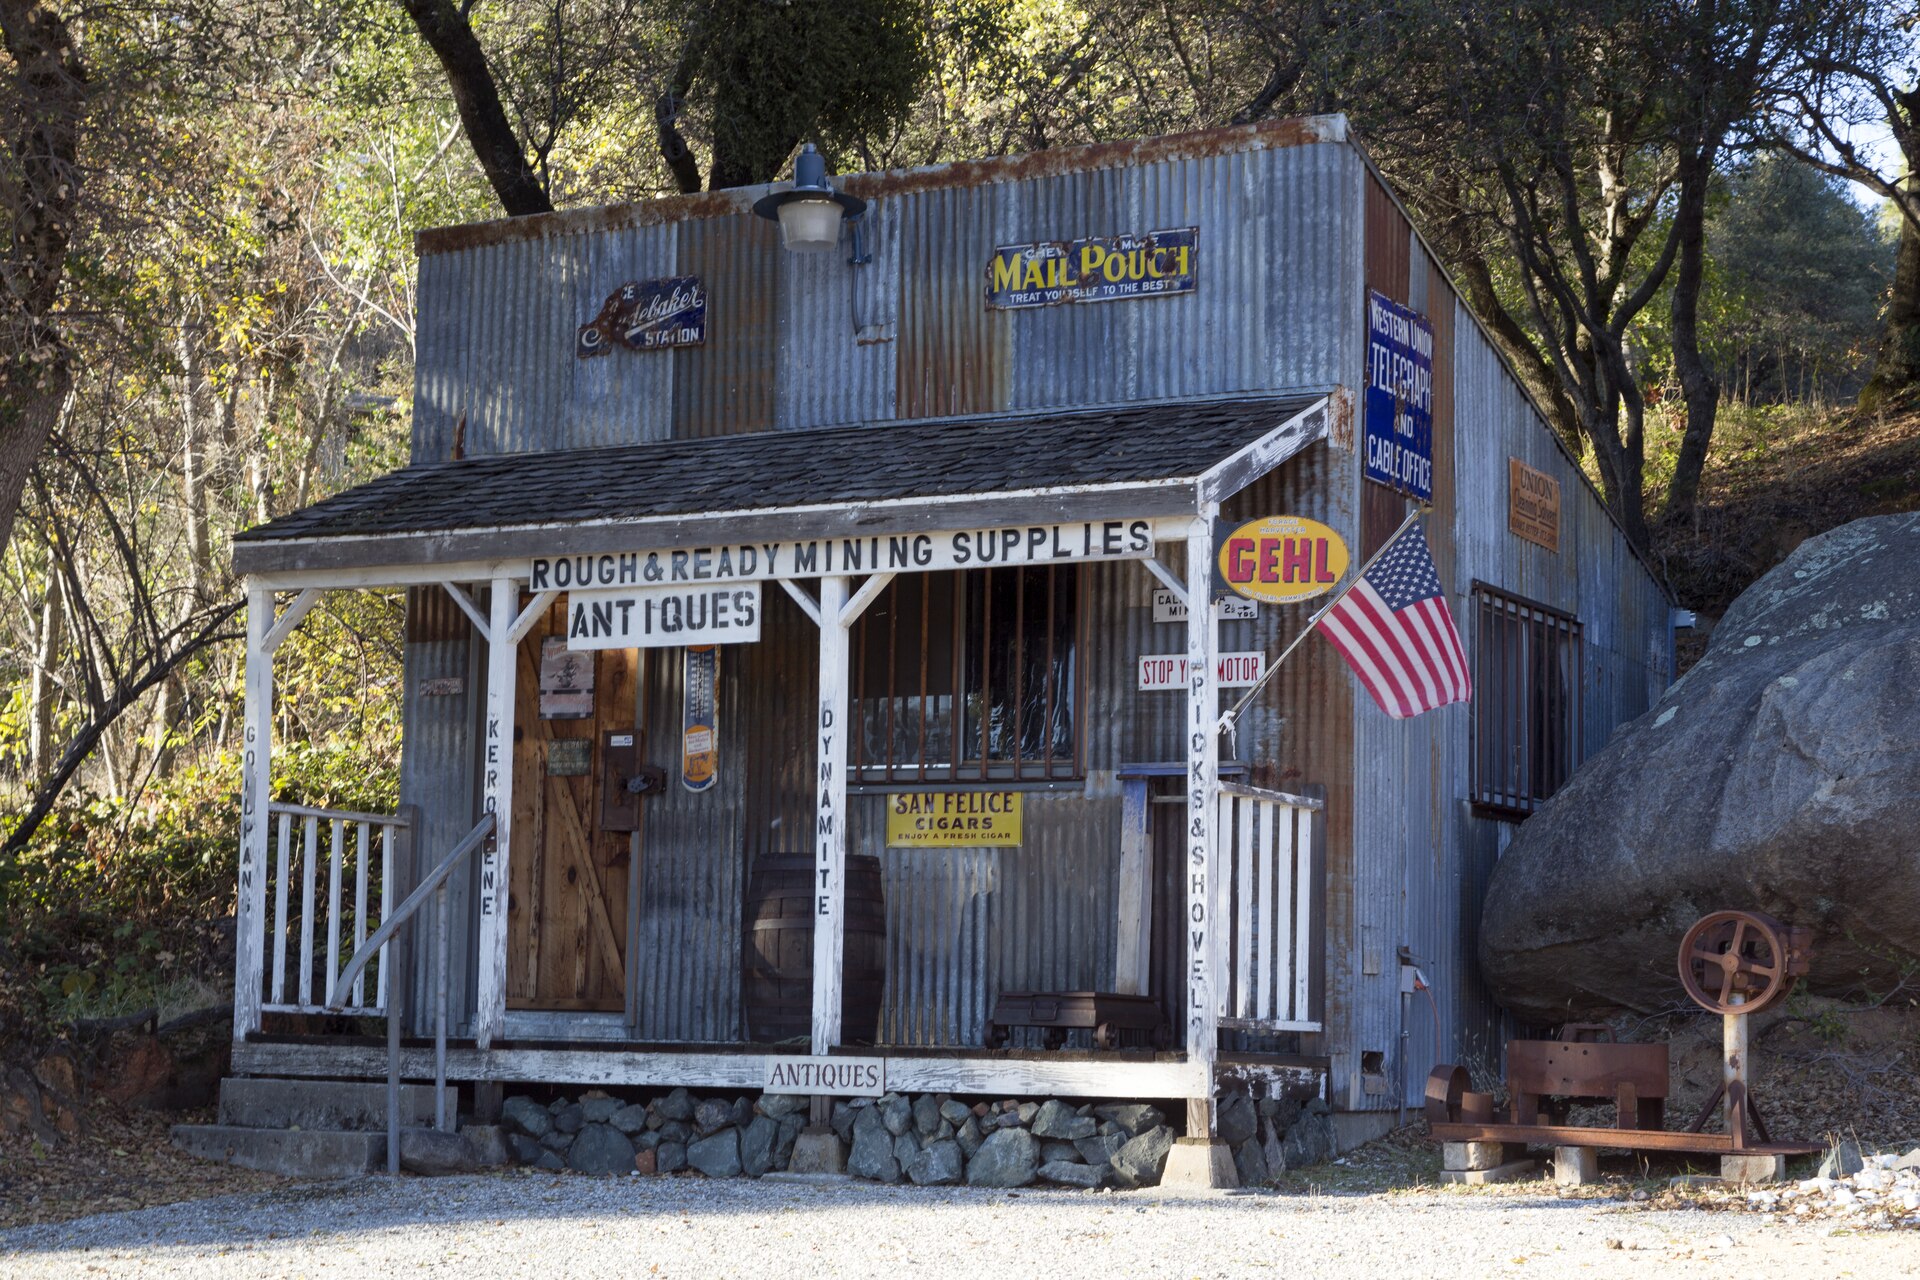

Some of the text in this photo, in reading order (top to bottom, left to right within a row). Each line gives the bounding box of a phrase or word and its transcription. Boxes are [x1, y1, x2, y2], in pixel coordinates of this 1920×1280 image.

[993, 244, 1189, 293] MAIL POUCH
[1010, 291, 1041, 304] TREAT
[1102, 284, 1117, 296] TO
[1119, 283, 1139, 293] THE
[1142, 279, 1171, 292] BEST
[645, 327, 699, 346] STATION
[1370, 298, 1433, 361] WESTERN UNION
[1371, 341, 1433, 416] TELEGRAPH
[1368, 433, 1432, 494] CABLE OFFICE
[1520, 466, 1553, 502] UNION
[794, 534, 933, 574] MINING
[952, 520, 1150, 563] SUPPLIES
[1228, 537, 1336, 583] GEHL
[570, 591, 755, 638] ANTIQUES
[1143, 660, 1174, 685] STOP
[1217, 657, 1258, 682] MOTOR
[482, 720, 499, 915] KEROENE
[818, 709, 833, 915] DYNAMITE
[895, 792, 1014, 815] SAN FELICE
[915, 816, 993, 831] CIGARS
[898, 832, 929, 840] ENJOY
[943, 832, 977, 840] FRESH
[981, 832, 1011, 840] CIGAR
[769, 1062, 879, 1090] ANTIQUES
